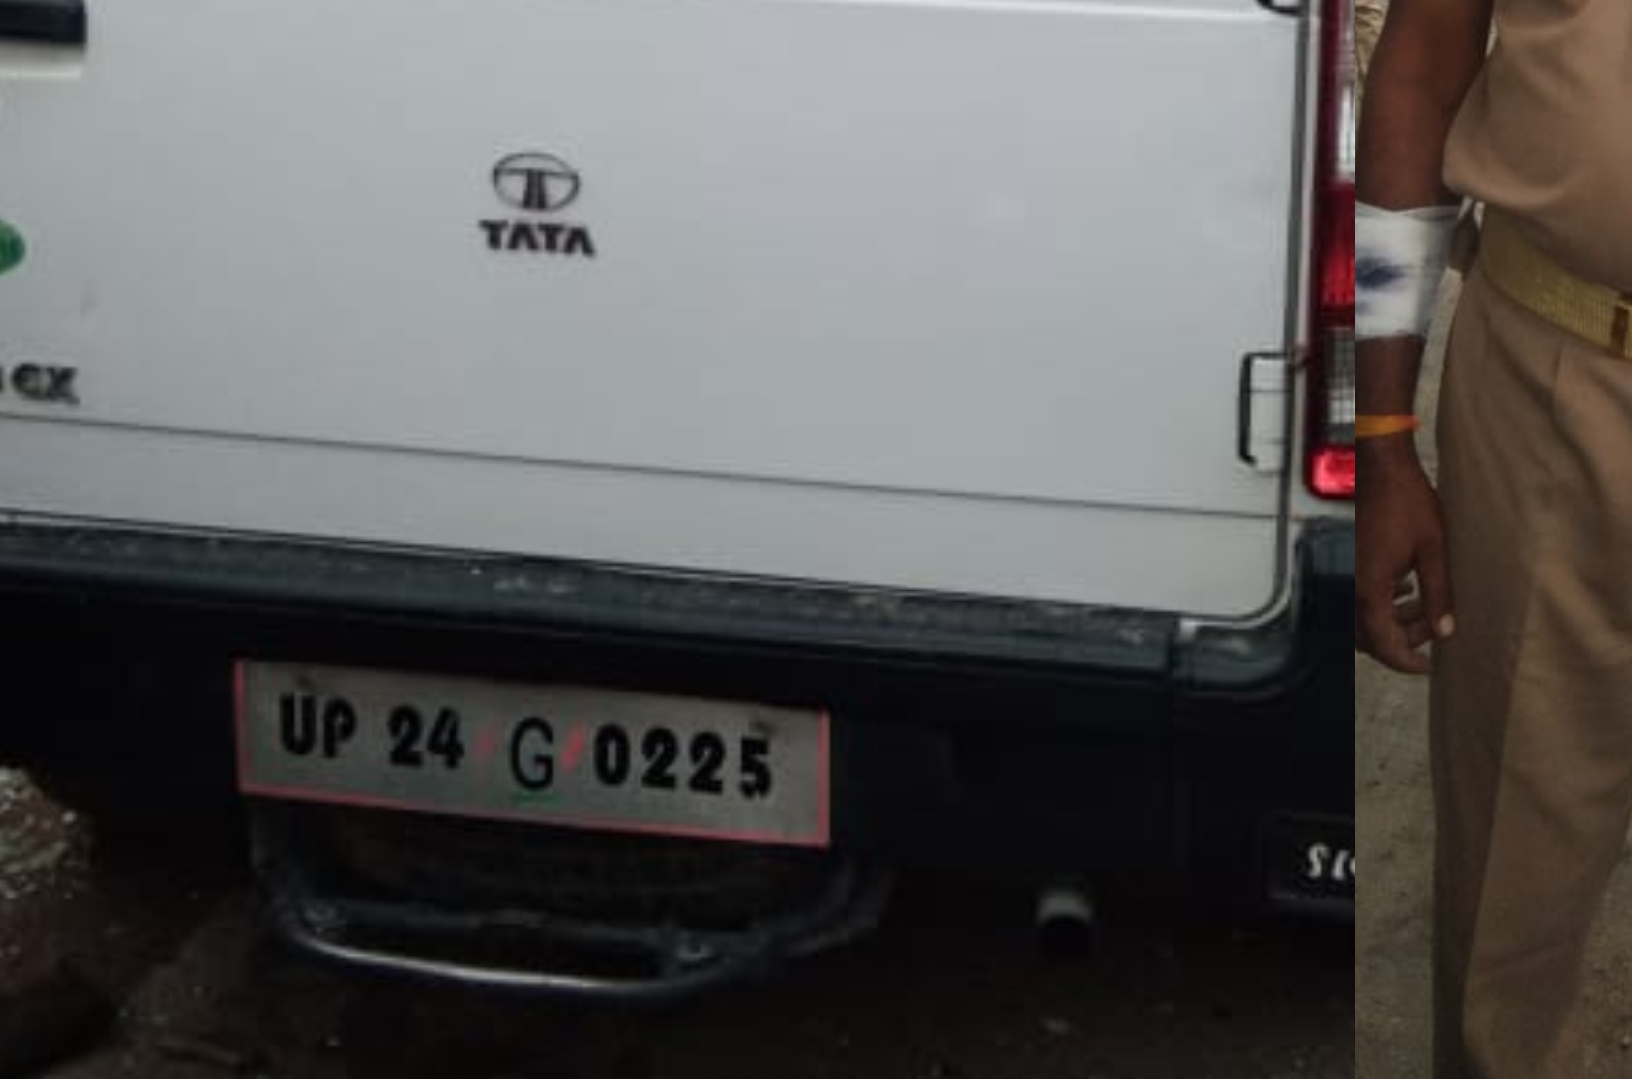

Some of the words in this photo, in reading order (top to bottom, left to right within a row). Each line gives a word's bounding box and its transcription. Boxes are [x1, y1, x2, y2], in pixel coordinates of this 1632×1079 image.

[478, 219, 596, 258] TATA
[279, 691, 358, 759] UP
[387, 704, 466, 769] 24
[593, 725, 773, 800] 0225
